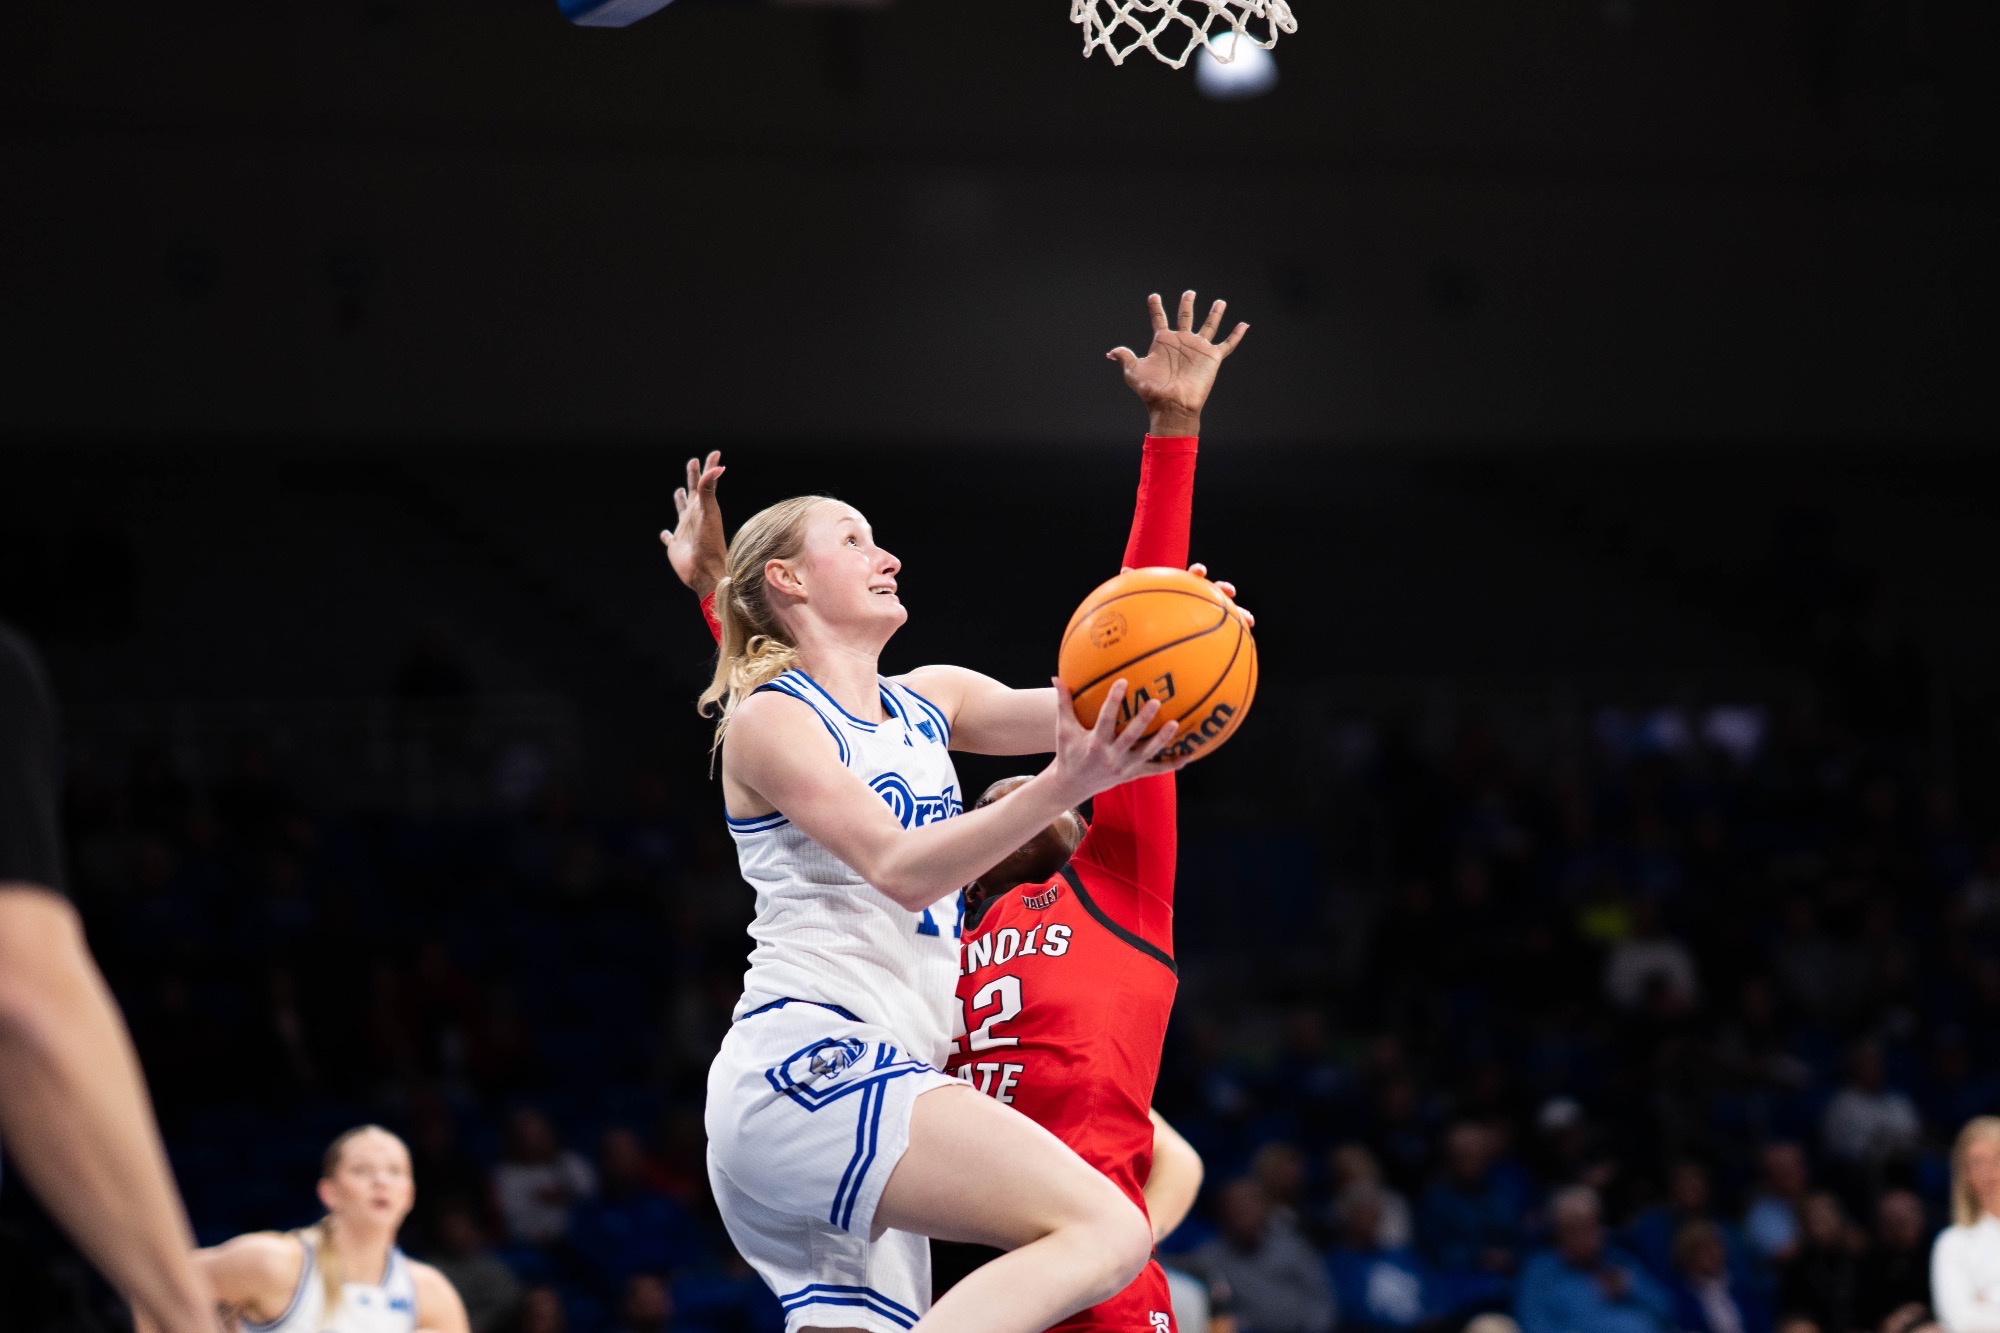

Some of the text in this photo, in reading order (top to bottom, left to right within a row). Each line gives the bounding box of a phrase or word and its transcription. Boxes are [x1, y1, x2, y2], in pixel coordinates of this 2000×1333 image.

[1021, 884, 1058, 909] VALLEY
[960, 923, 1072, 975] NOIS
[952, 1062, 1024, 1104] ATE
